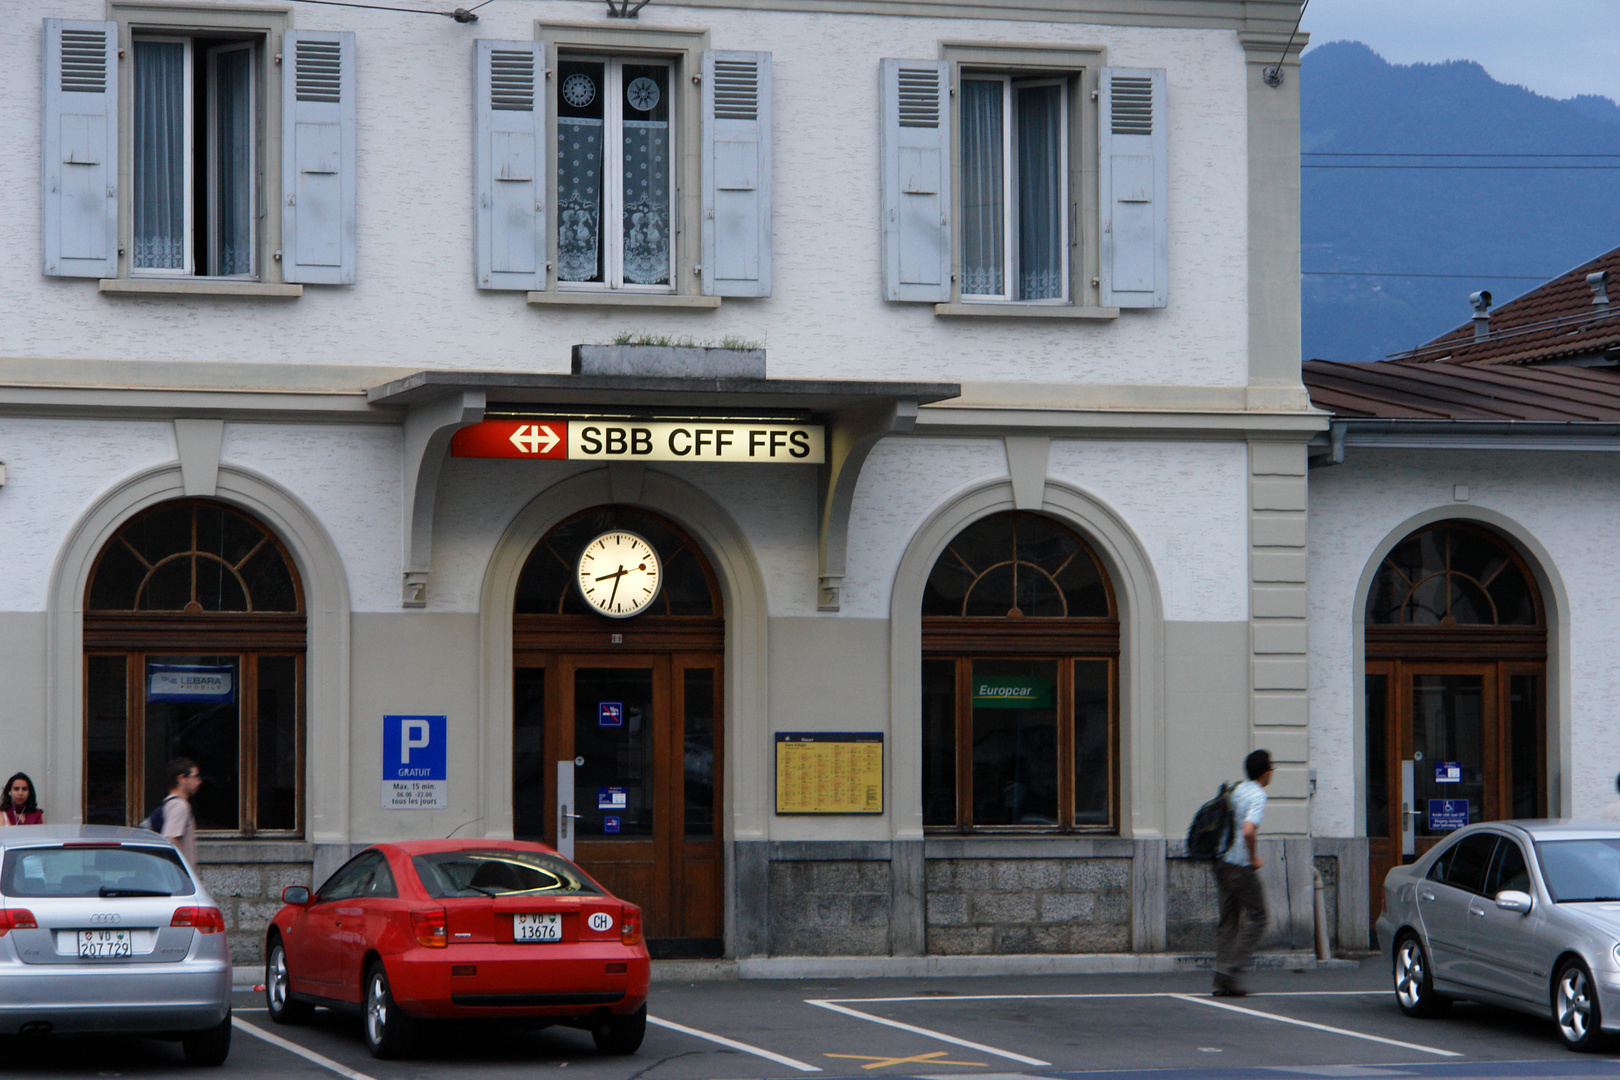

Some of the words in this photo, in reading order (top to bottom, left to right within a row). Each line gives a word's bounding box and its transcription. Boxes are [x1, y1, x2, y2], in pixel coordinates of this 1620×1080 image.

[580, 426, 653, 455] SBB
[668, 428, 734, 457] CFF
[748, 430, 810, 459] FFS
[180, 676, 221, 685] LEBARA
[979, 684, 1032, 698] Europcar
[400, 719, 430, 764] P
[398, 768, 431, 777] GRATUIT
[408, 797, 418, 805] les
[419, 798, 437, 806] jours
[532, 914, 544, 923] VD
[593, 915, 608, 929] CH
[98, 931, 111, 941] VD
[521, 925, 556, 938] 13676
